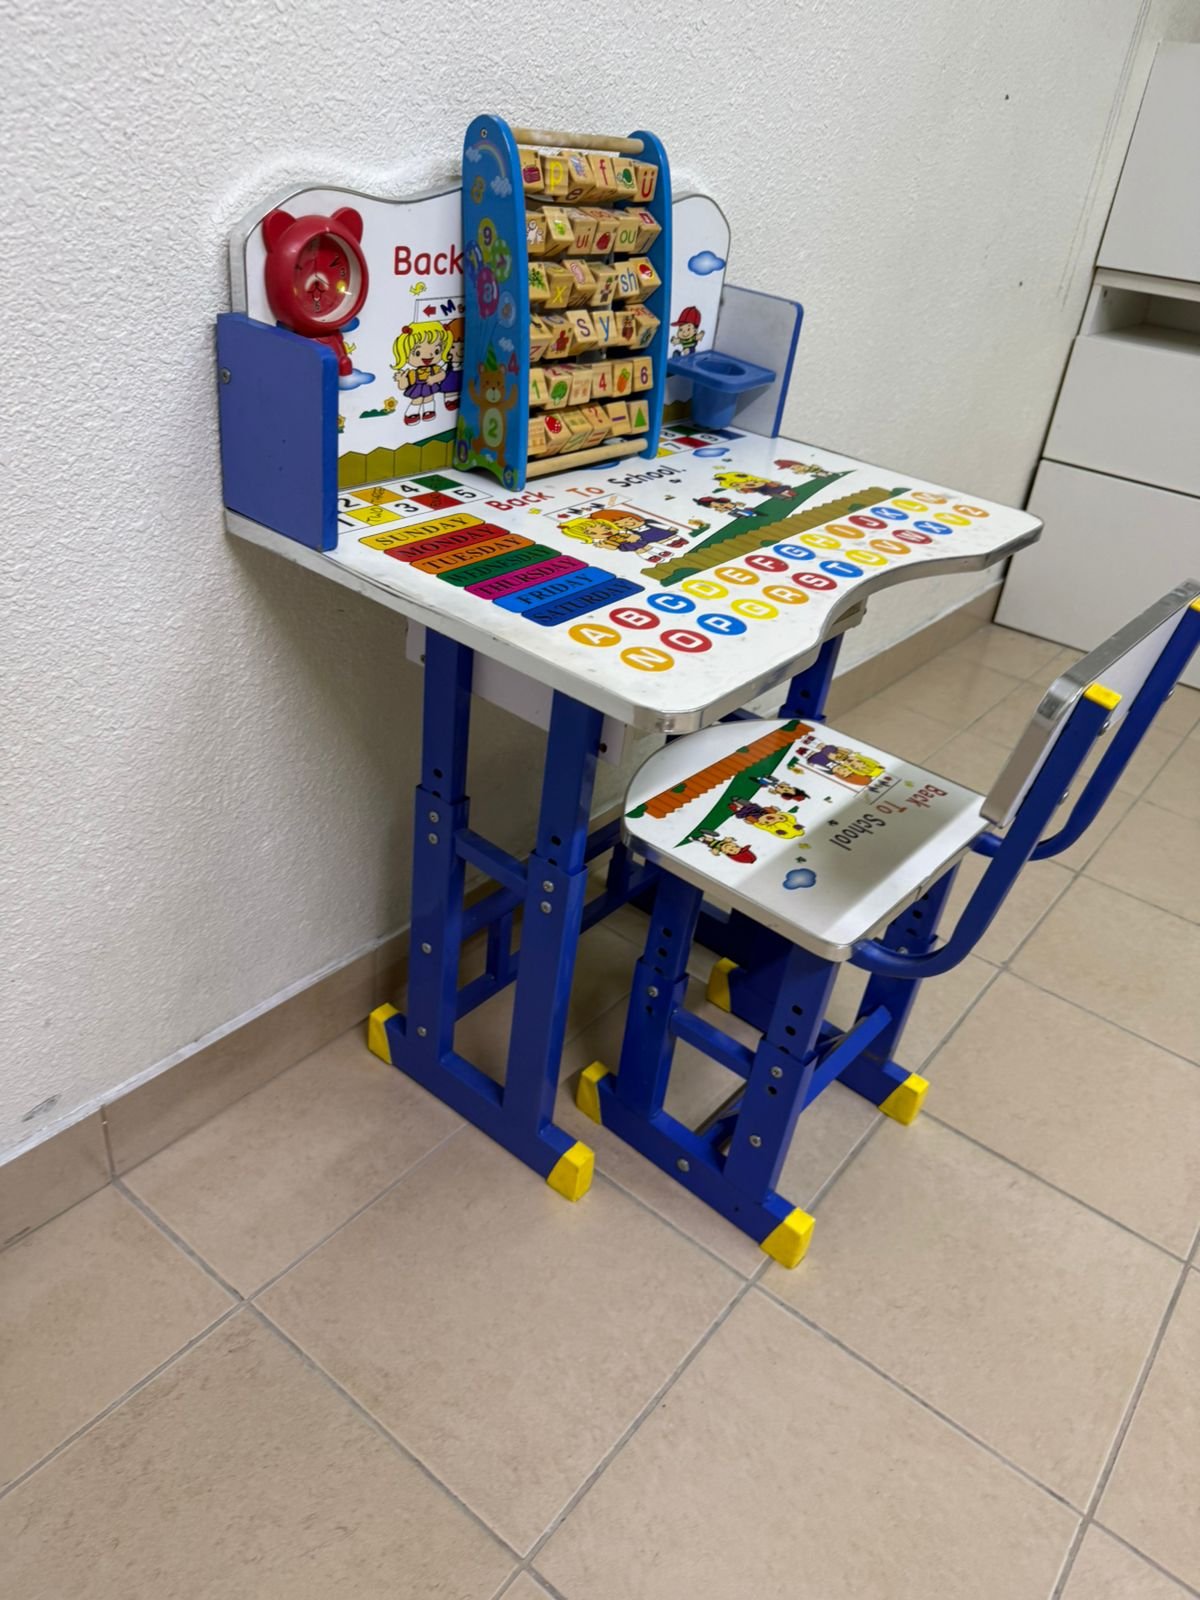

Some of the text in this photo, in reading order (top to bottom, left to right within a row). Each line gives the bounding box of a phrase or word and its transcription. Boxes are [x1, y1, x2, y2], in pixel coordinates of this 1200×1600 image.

[549, 160, 564, 192] p
[599, 159, 609, 186] f
[483, 226, 493, 247] 9
[619, 230, 636, 244] ou
[393, 244, 465, 276] Back
[620, 267, 639, 293] sh
[599, 315, 610, 343] y
[507, 351, 520, 376] 4
[598, 372, 607, 392] 4
[640, 366, 649, 385] 6
[487, 417, 498, 439] 2
[401, 484, 421, 493] 4
[453, 489, 477, 499] 5
[484, 490, 555, 511] Back
[565, 487, 606, 498] To
[339, 497, 361, 508] 2
[394, 502, 419, 512] 3
[375, 516, 470, 546] SUNDAY
[400, 526, 495, 558] MONDAY
[422, 537, 521, 570] TUESDAY
[450, 547, 550, 583] WEDNESDAY
[473, 558, 577, 597] THURSDAY
[579, 627, 615, 645] A
[616, 610, 653, 627] B
[654, 595, 688, 610] C
[687, 582, 721, 596] D
[720, 568, 754, 583] E
[751, 557, 776, 570] F
[781, 545, 810, 558] G
[805, 535, 837, 548] H
[859, 516, 881, 527] J
[875, 508, 903, 519] K
[904, 501, 922, 510] L
[517, 574, 593, 605] FRIDAY
[627, 648, 668, 668] N
[668, 632, 703, 649] O
[703, 616, 732, 632] P
[769, 587, 804, 601] R
[798, 574, 830, 588] S
[826, 561, 854, 574] T
[850, 549, 881, 563] U
[873, 540, 902, 551] V
[917, 521, 948, 533] X
[957, 506, 983, 516] Z
[532, 583, 630, 622] SATURDAY
[875, 800, 907, 815] To
[906, 784, 948, 809] Back
[829, 813, 887, 851] School
